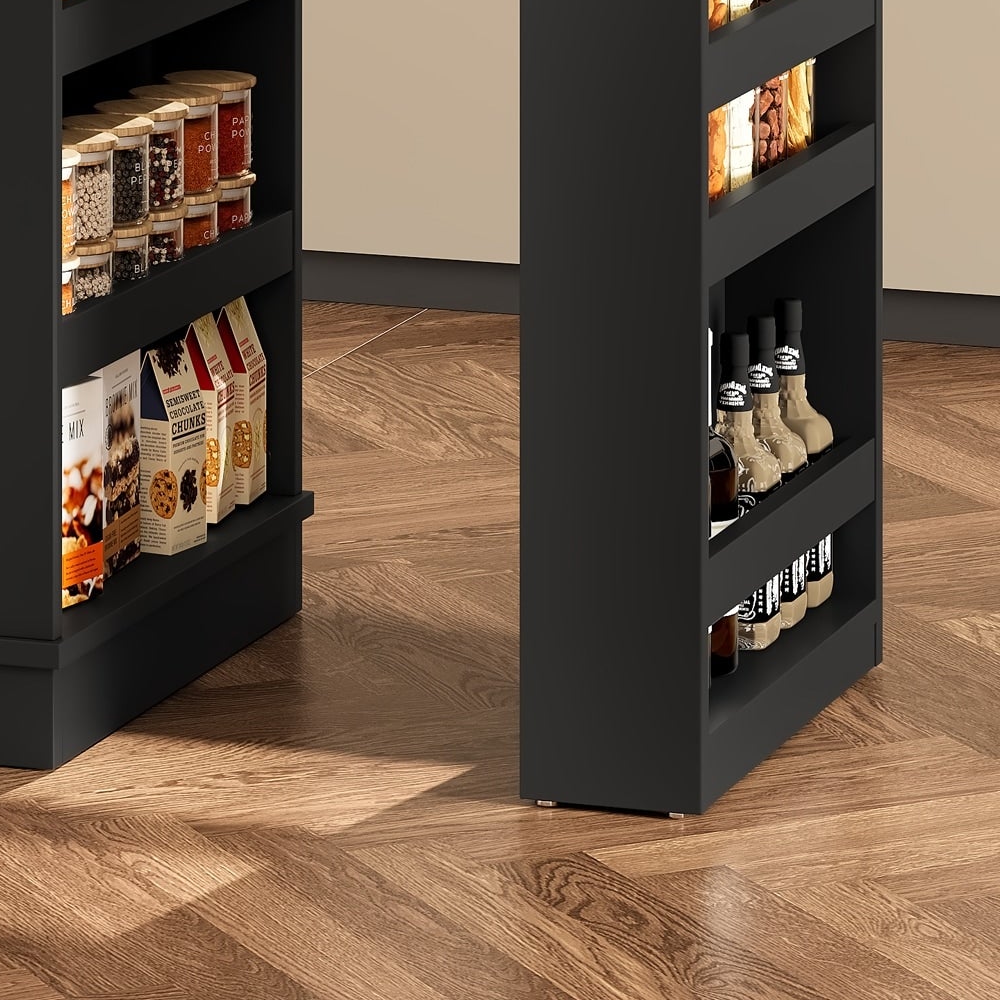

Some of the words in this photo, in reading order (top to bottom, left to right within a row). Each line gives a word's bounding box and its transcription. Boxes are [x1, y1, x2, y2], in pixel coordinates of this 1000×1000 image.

[128, 378, 138, 402] MIX
[165, 389, 201, 408] SEMISWEET
[169, 400, 205, 420] CHOCOLATE
[68, 418, 85, 441] MIX
[171, 412, 206, 435] CHUNKS
